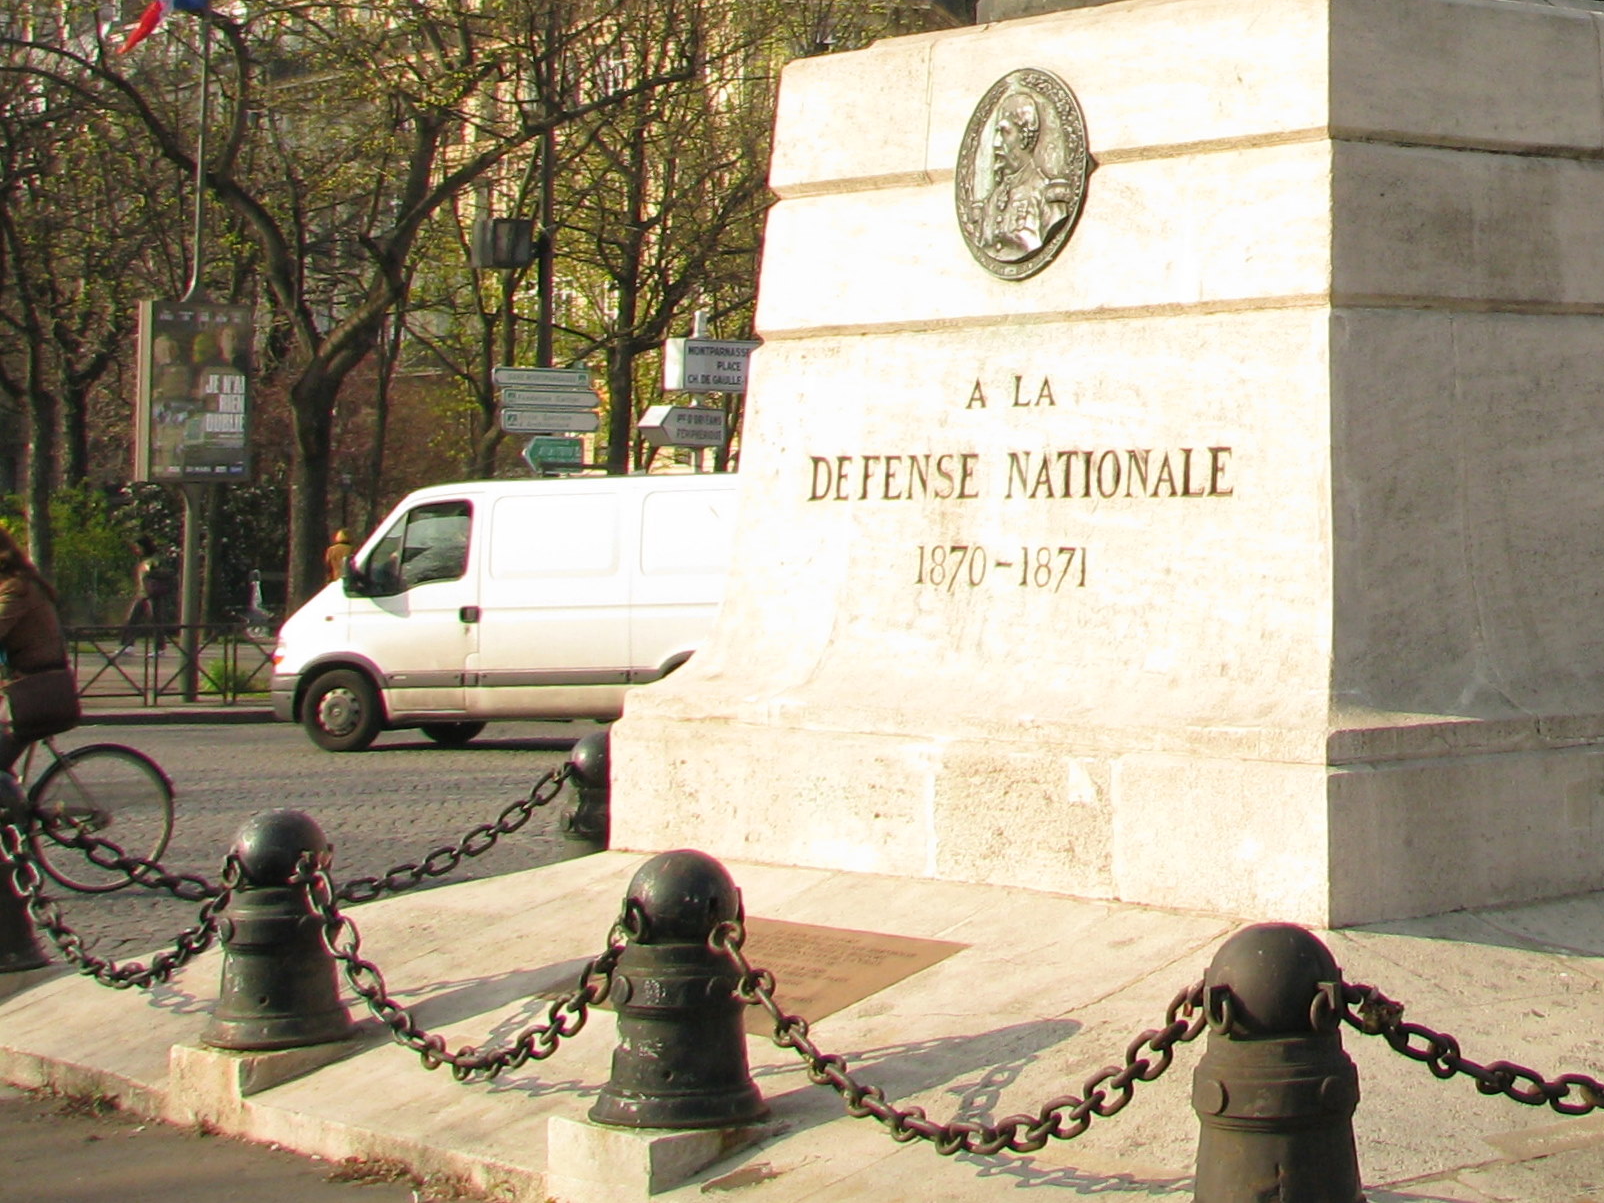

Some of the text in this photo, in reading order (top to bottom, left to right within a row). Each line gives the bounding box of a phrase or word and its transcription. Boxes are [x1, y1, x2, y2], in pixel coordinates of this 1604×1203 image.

[716, 361, 742, 371] PLACE
[965, 375, 1057, 410] A LA
[808, 446, 1234, 502] DEFENSE NATIONALE
